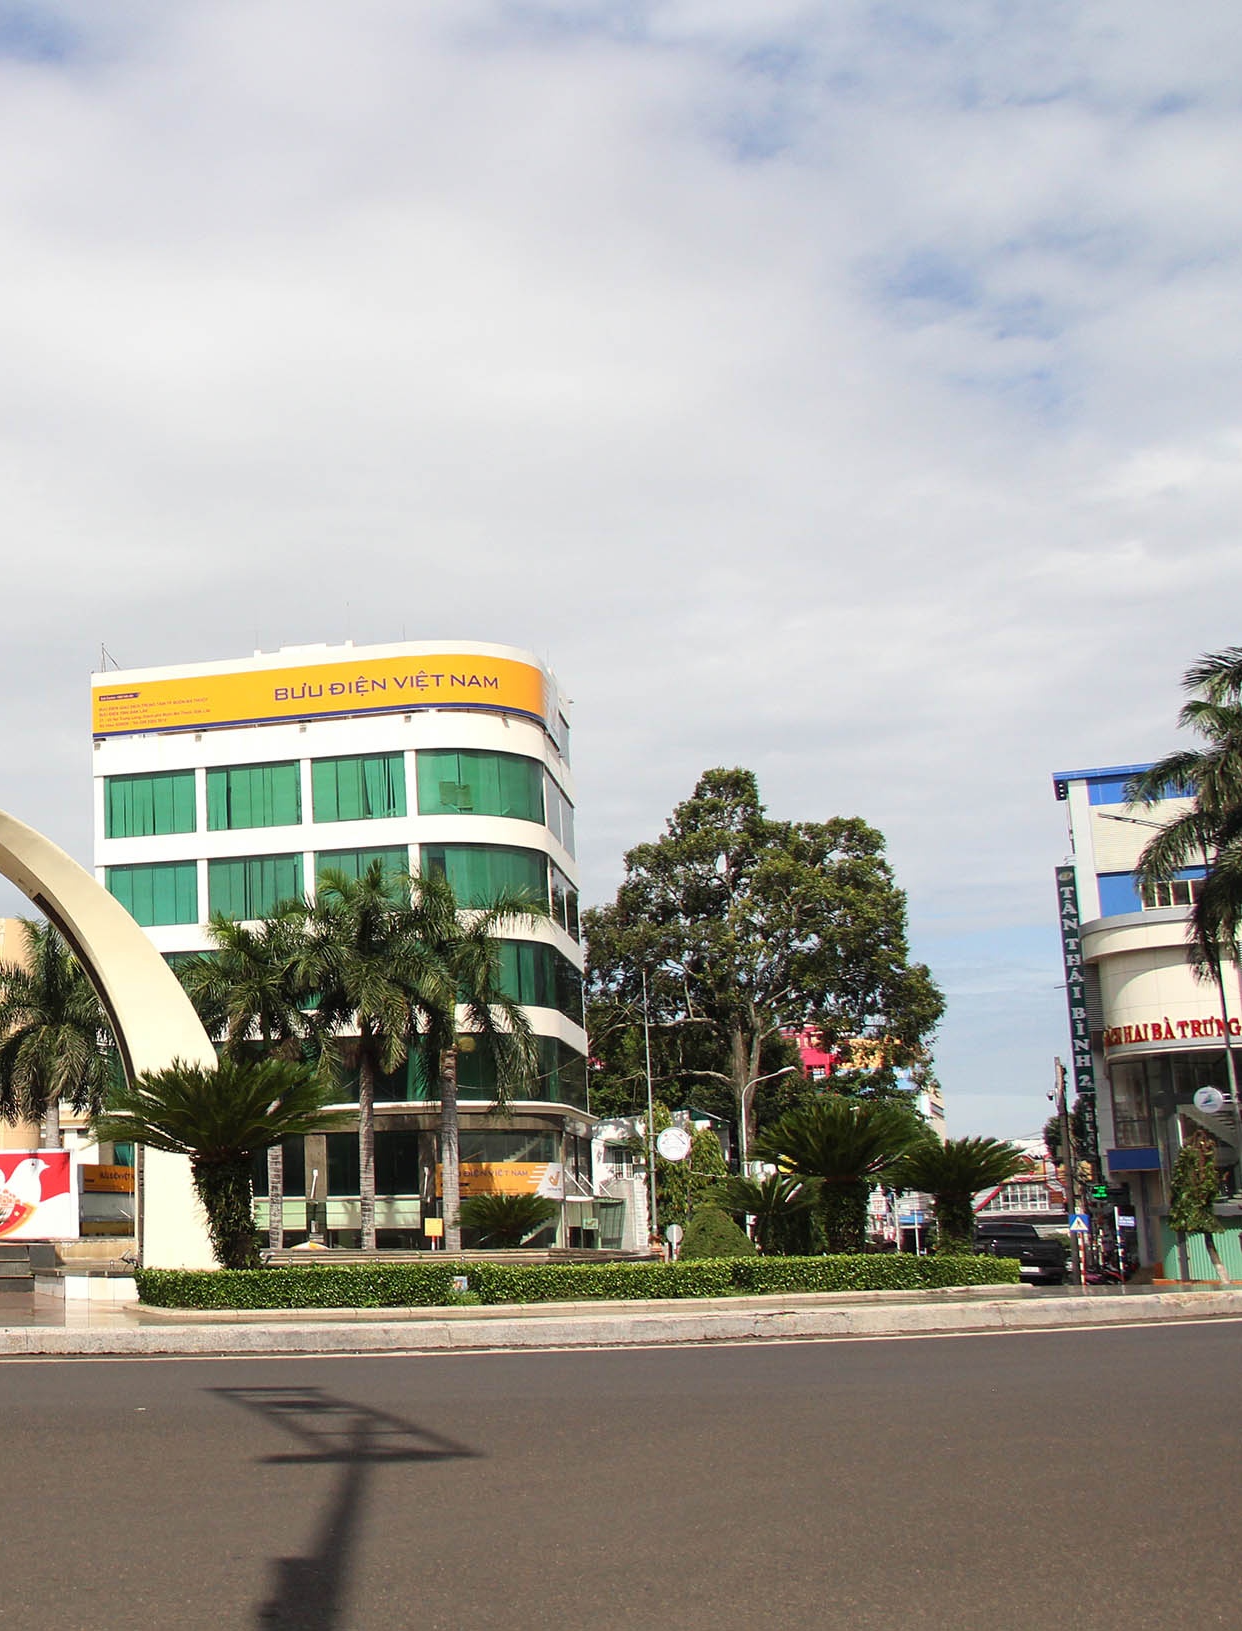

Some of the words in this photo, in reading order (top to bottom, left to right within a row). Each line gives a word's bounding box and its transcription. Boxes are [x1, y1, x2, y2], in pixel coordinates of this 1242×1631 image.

[274, 682, 323, 701] BƯU
[329, 675, 387, 697] ĐIỆN
[393, 670, 445, 692] VIỆT
[450, 673, 499, 689] NAM
[1060, 885, 1078, 931] TÂN
[1065, 937, 1085, 999] THÁI
[1071, 1007, 1092, 1068] BÌNH
[1123, 1023, 1150, 1045] HAI
[1150, 1016, 1176, 1041] BÀ
